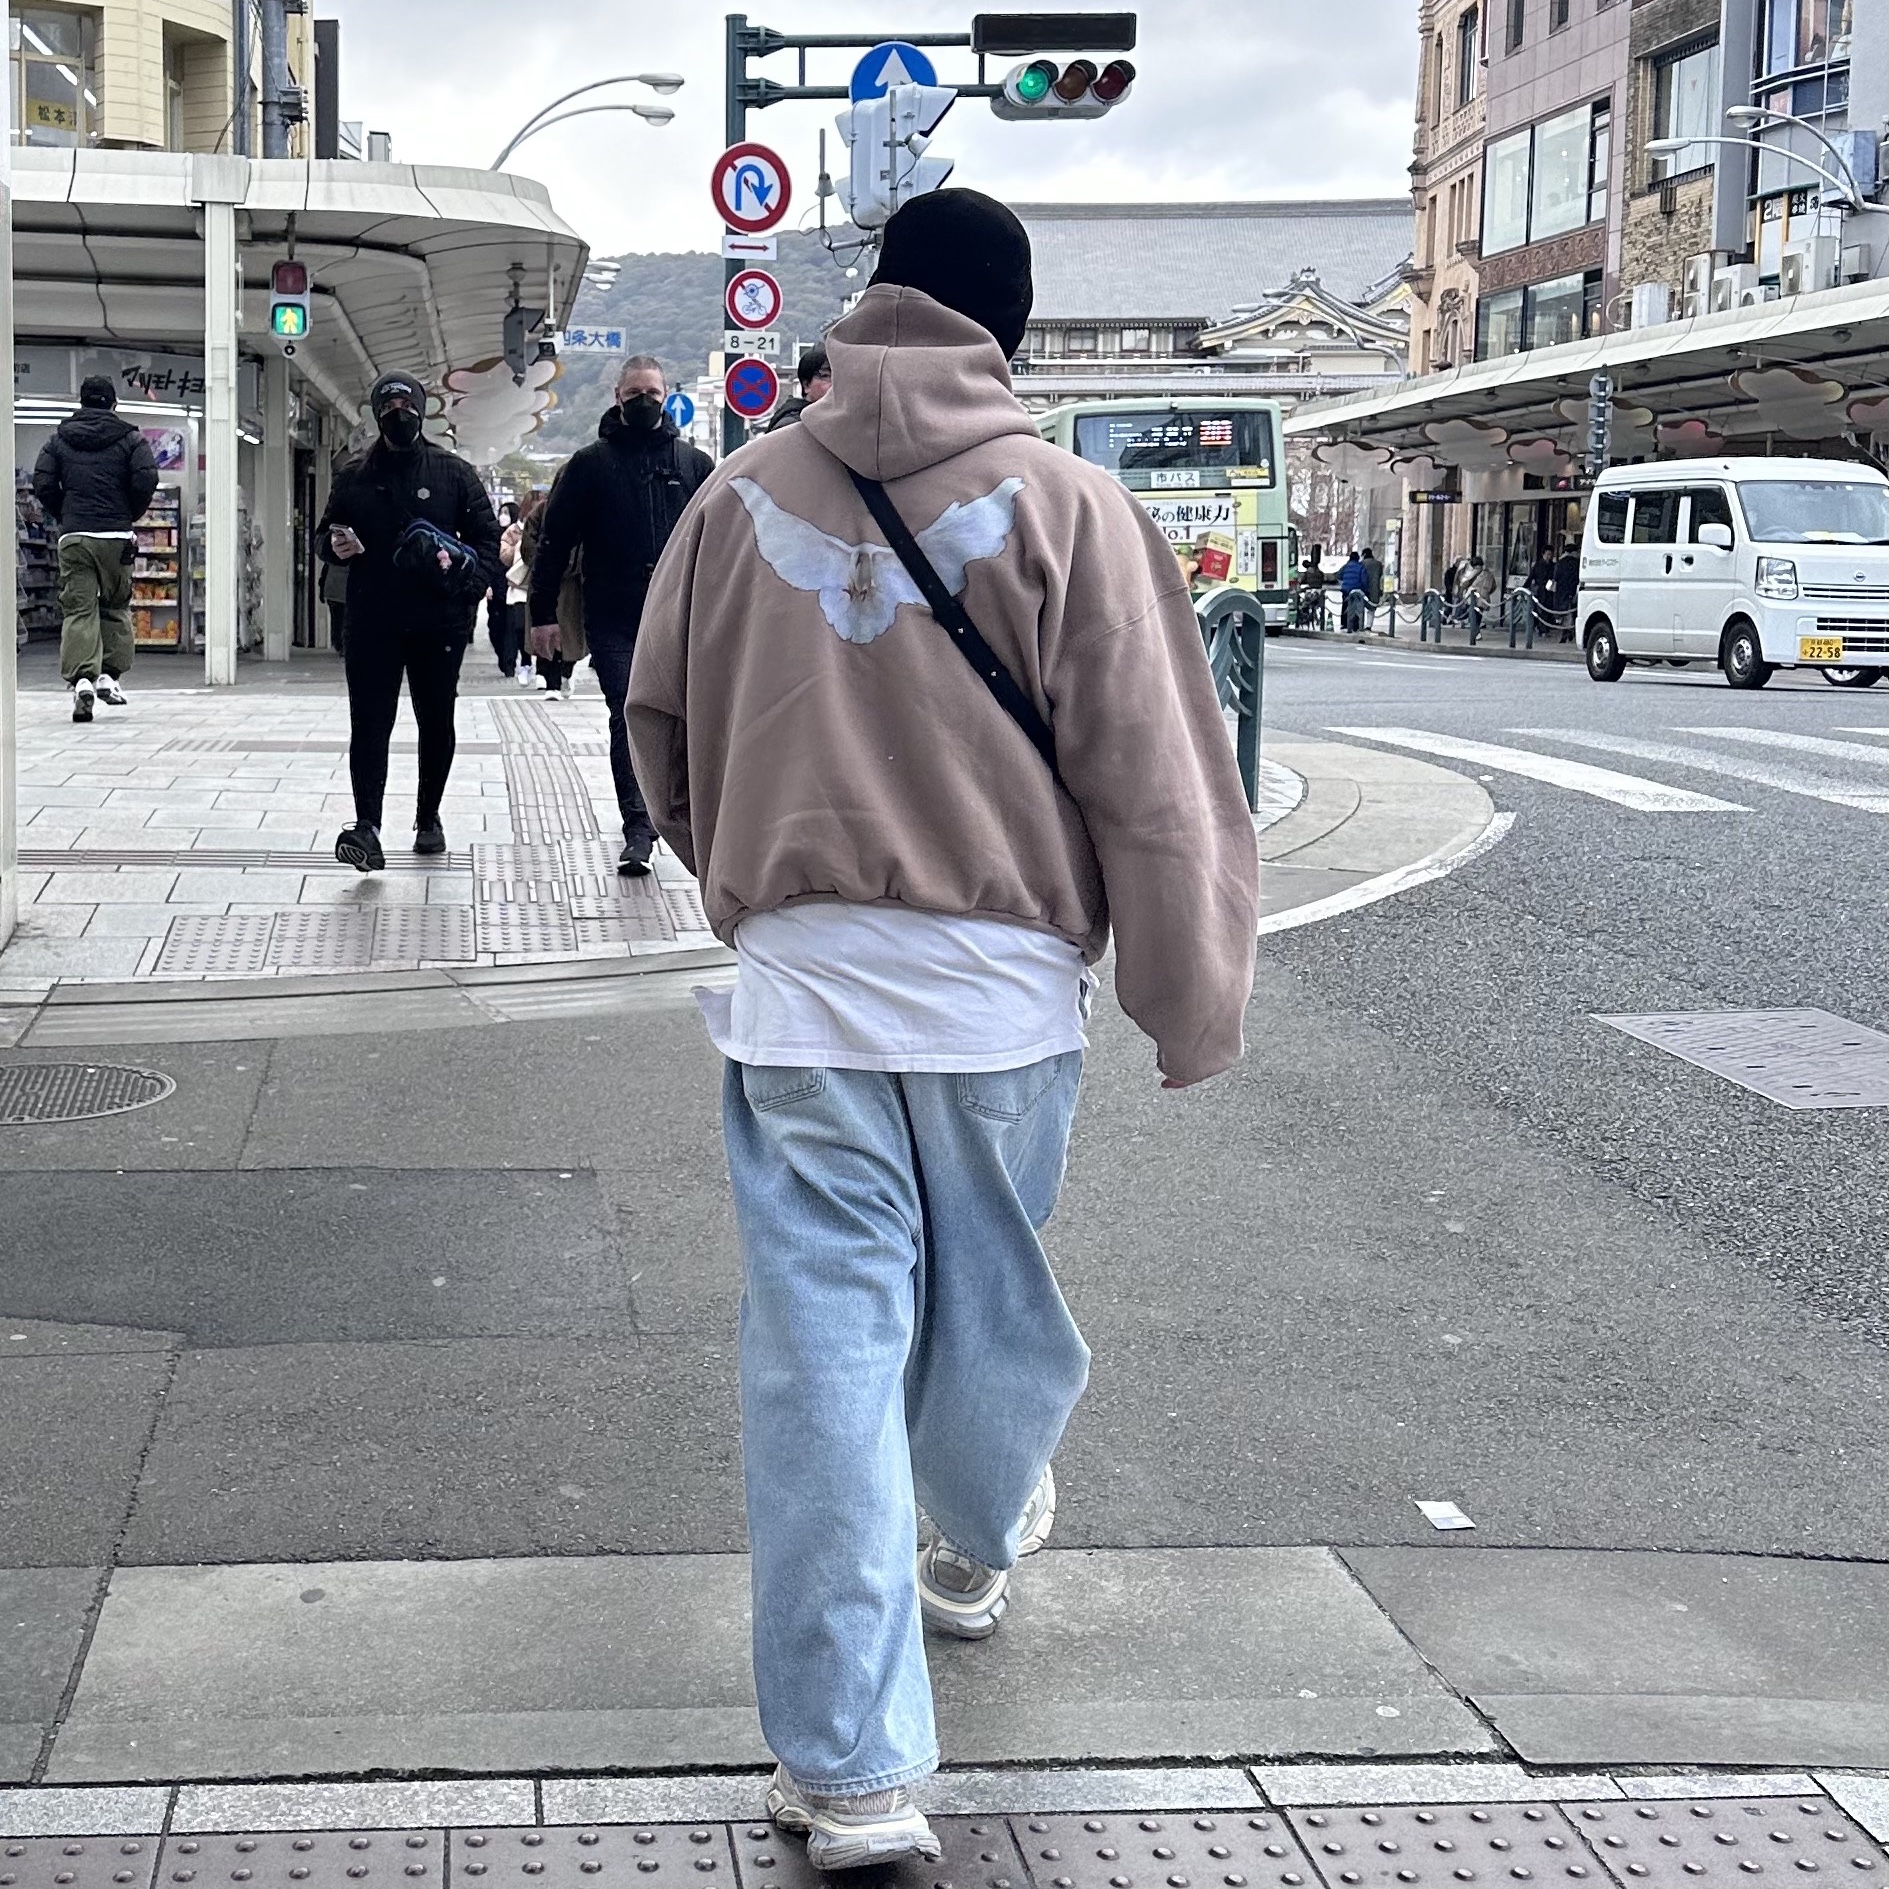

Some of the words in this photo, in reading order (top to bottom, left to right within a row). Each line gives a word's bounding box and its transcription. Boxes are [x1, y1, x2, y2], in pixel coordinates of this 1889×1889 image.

[731, 335, 774, 350] 8-21
[1156, 472, 1195, 483] 市バス
